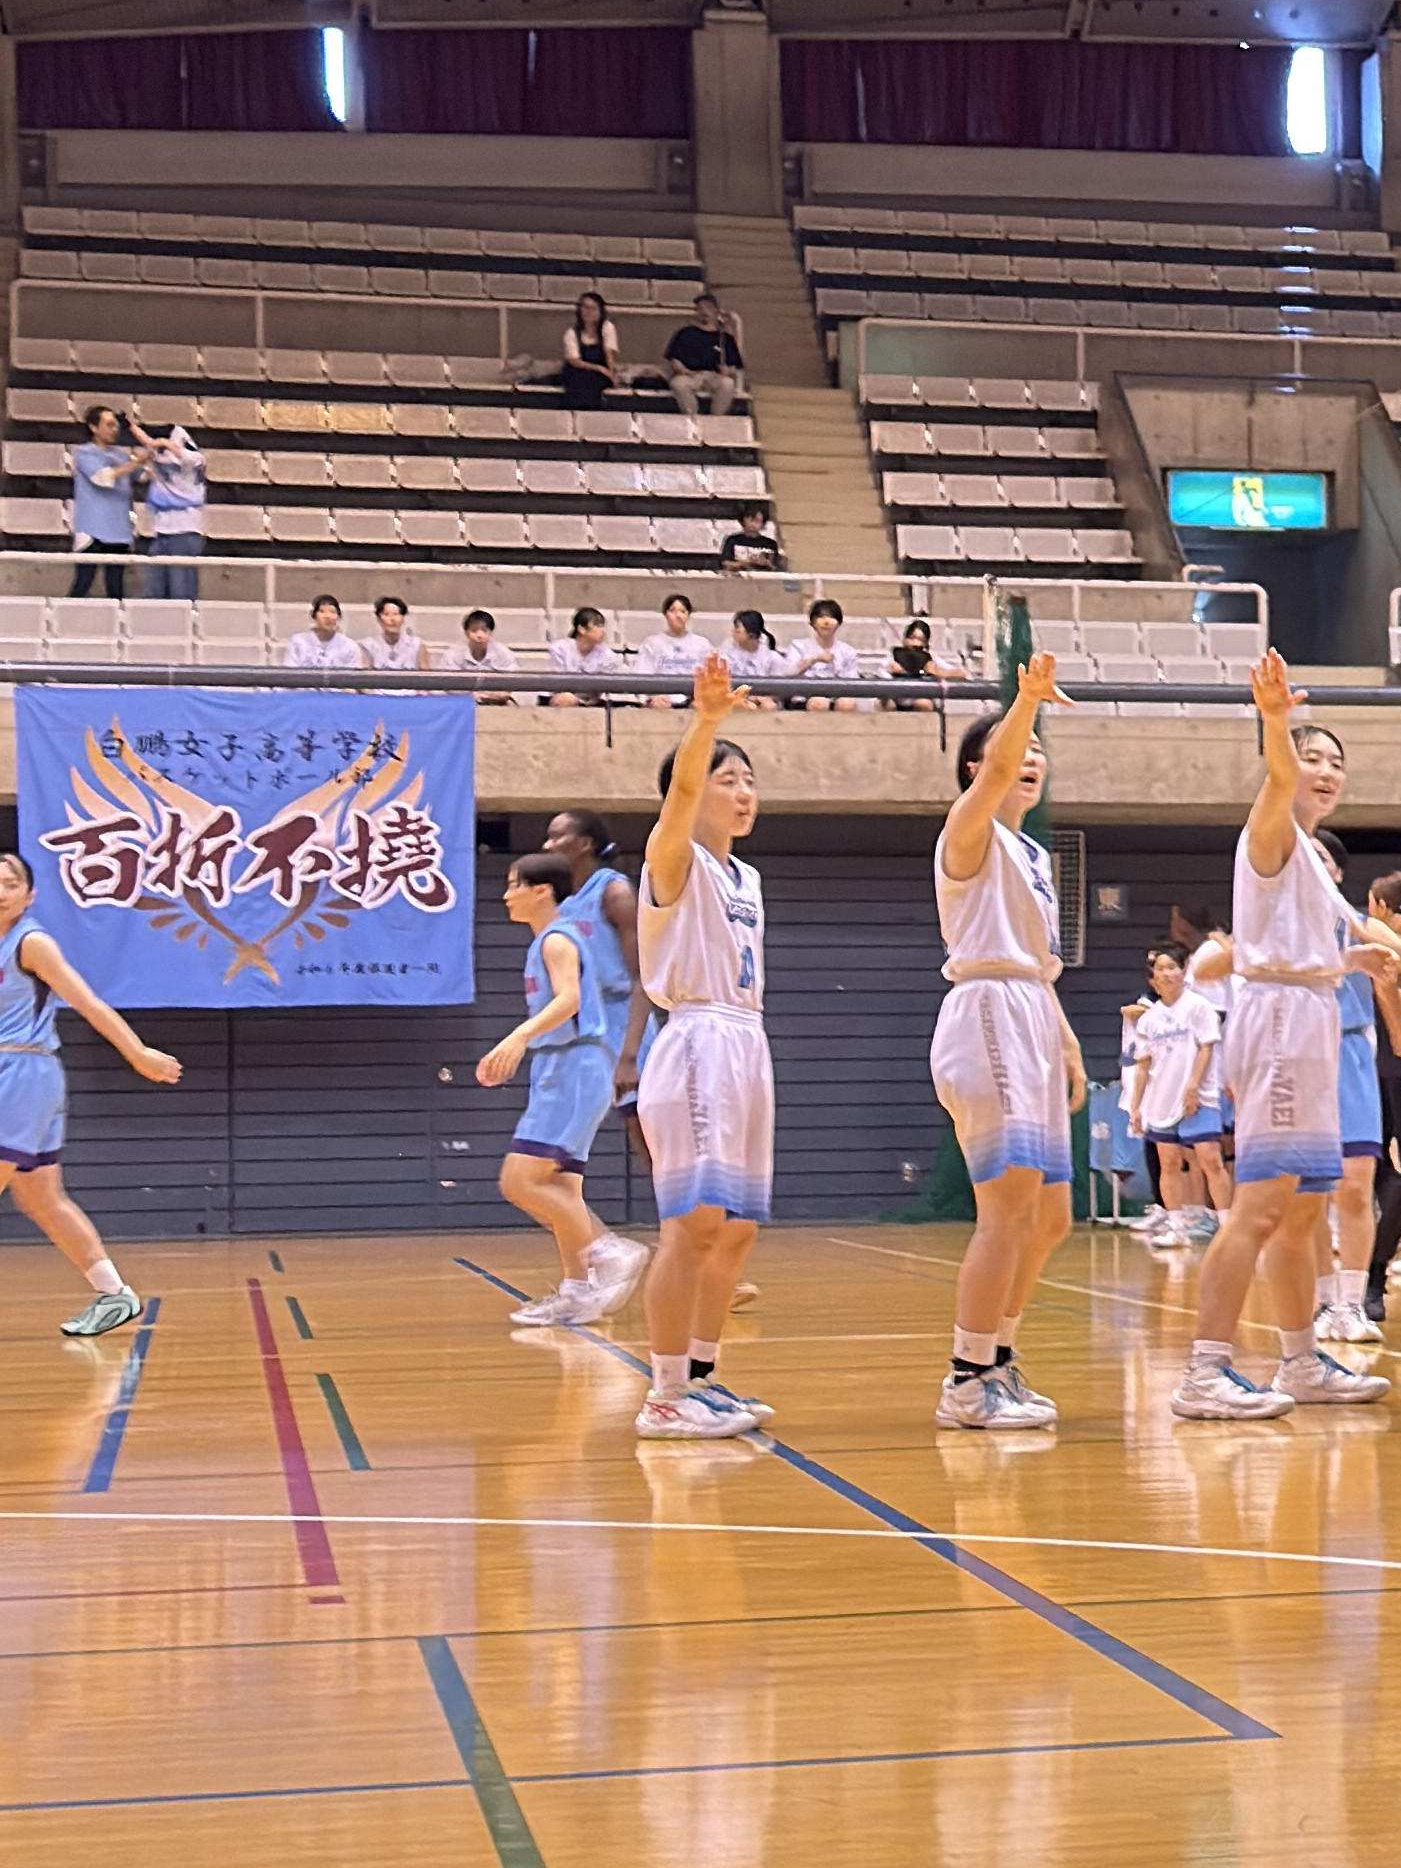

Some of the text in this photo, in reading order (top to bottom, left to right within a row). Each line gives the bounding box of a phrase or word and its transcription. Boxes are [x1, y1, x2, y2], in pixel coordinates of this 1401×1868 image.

[101, 729, 404, 763] 白鵬女子高等学校
[41, 802, 456, 910] 百折不撓
[1271, 1076, 1294, 1128] YAEI
